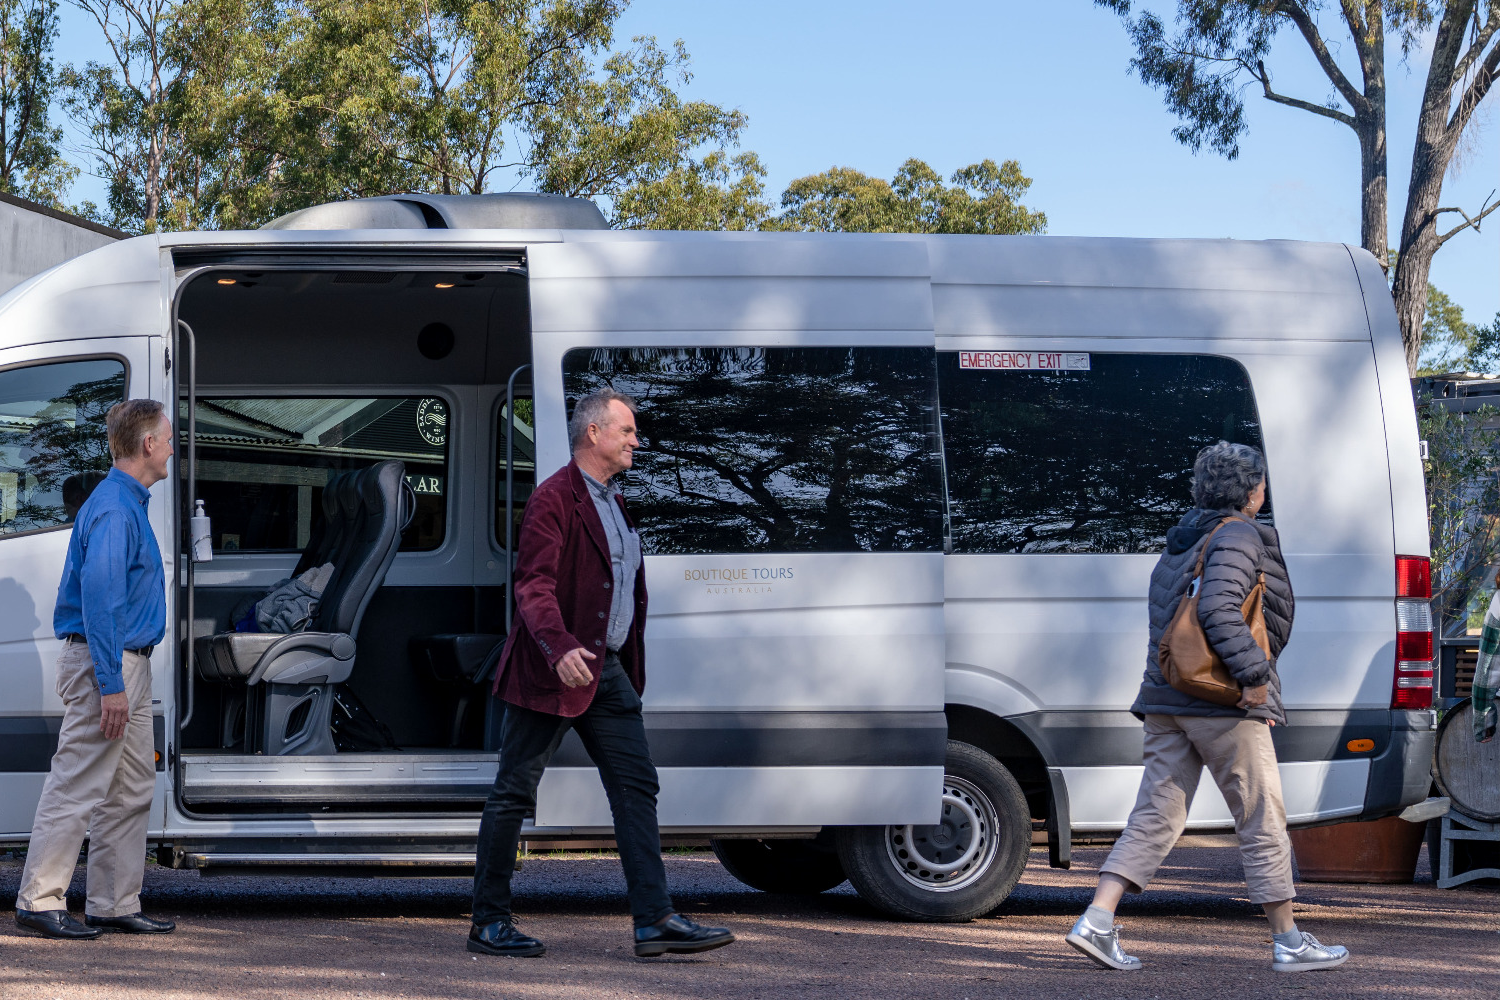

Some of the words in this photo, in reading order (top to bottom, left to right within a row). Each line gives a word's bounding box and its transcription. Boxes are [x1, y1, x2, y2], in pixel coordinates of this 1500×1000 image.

[960, 353, 1032, 368] EMERGENCY
[1038, 353, 1062, 369] EXIT
[684, 568, 748, 581] BOUTIQUE
[752, 567, 794, 579] TOURS
[706, 586, 772, 594] AUSTRALIA
